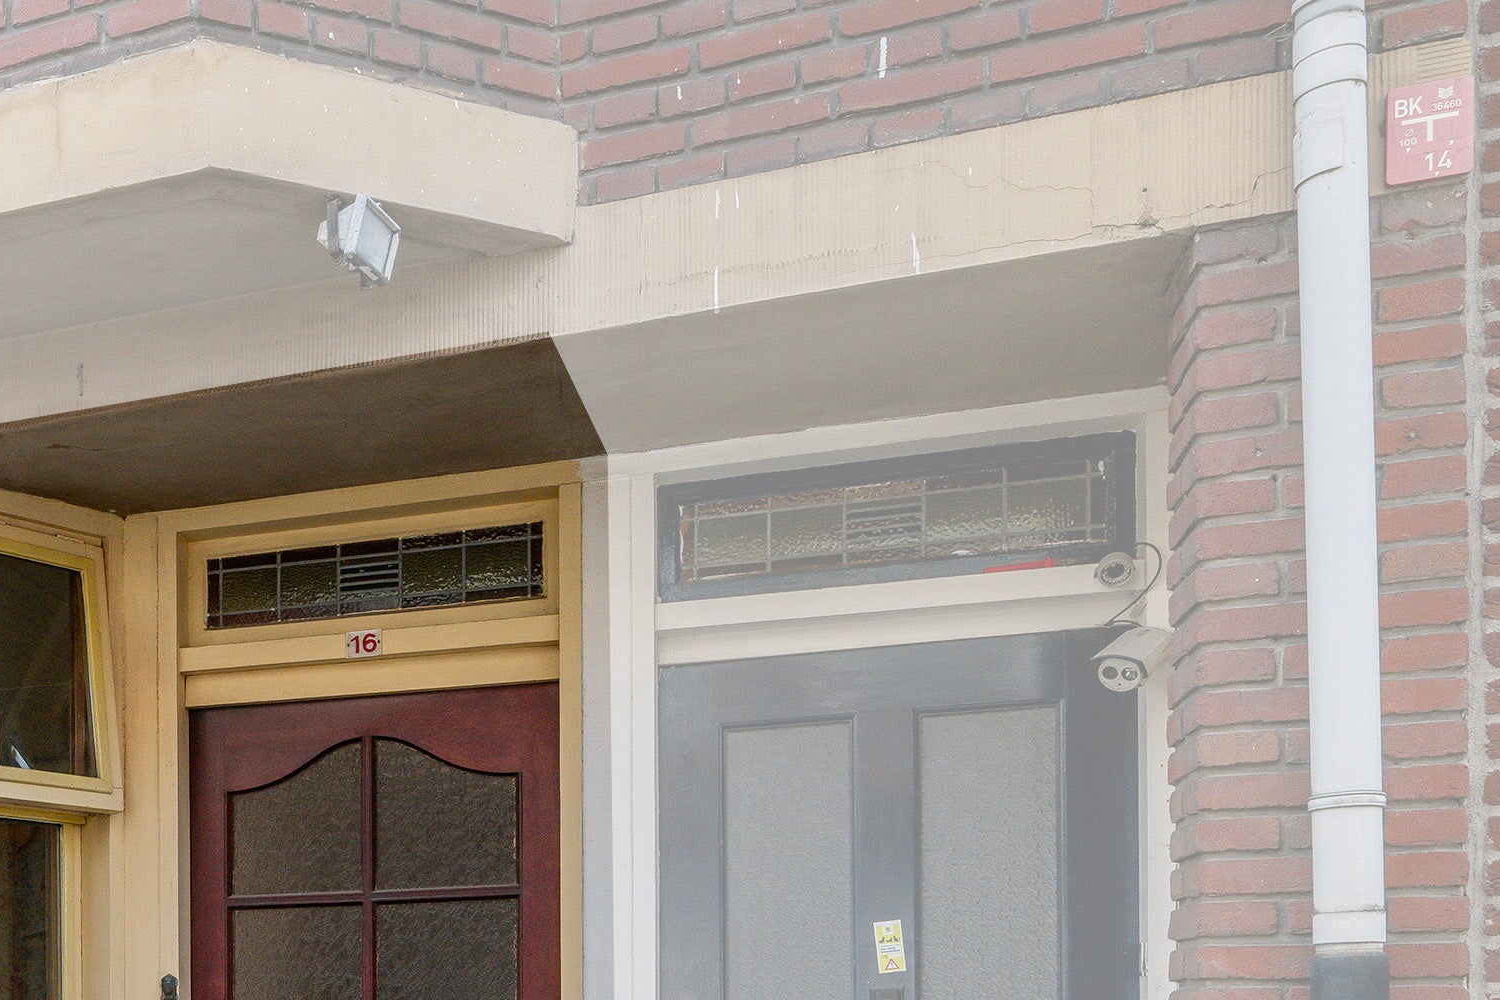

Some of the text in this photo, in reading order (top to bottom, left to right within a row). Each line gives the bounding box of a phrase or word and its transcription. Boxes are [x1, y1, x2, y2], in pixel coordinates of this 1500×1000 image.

[1395, 95, 1424, 119] BK
[1431, 98, 1462, 111] 36460
[351, 633, 377, 653] 16
